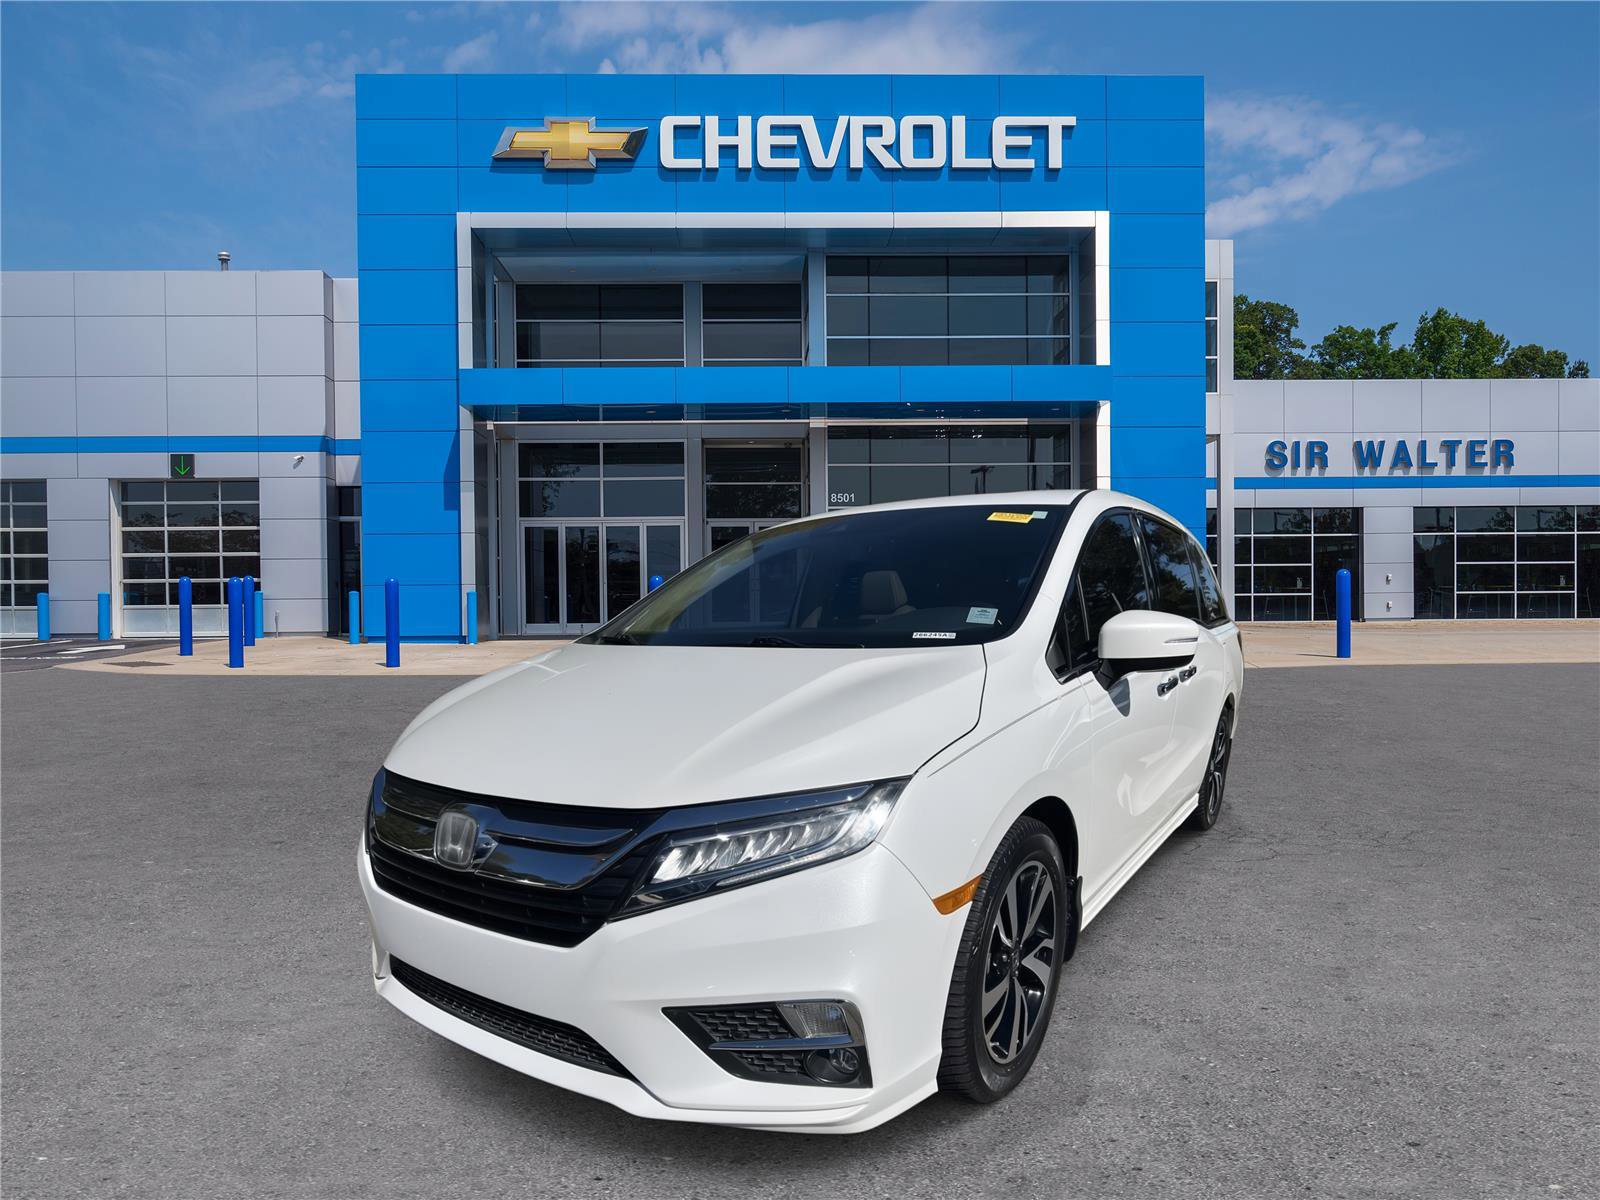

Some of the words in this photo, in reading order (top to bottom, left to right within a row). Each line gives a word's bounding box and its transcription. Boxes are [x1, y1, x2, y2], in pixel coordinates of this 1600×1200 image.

[659, 115, 1077, 169] CHEVROLET
[1265, 439, 1329, 469] SIR
[1354, 439, 1515, 469] WALTER
[830, 493, 855, 503] 8501
